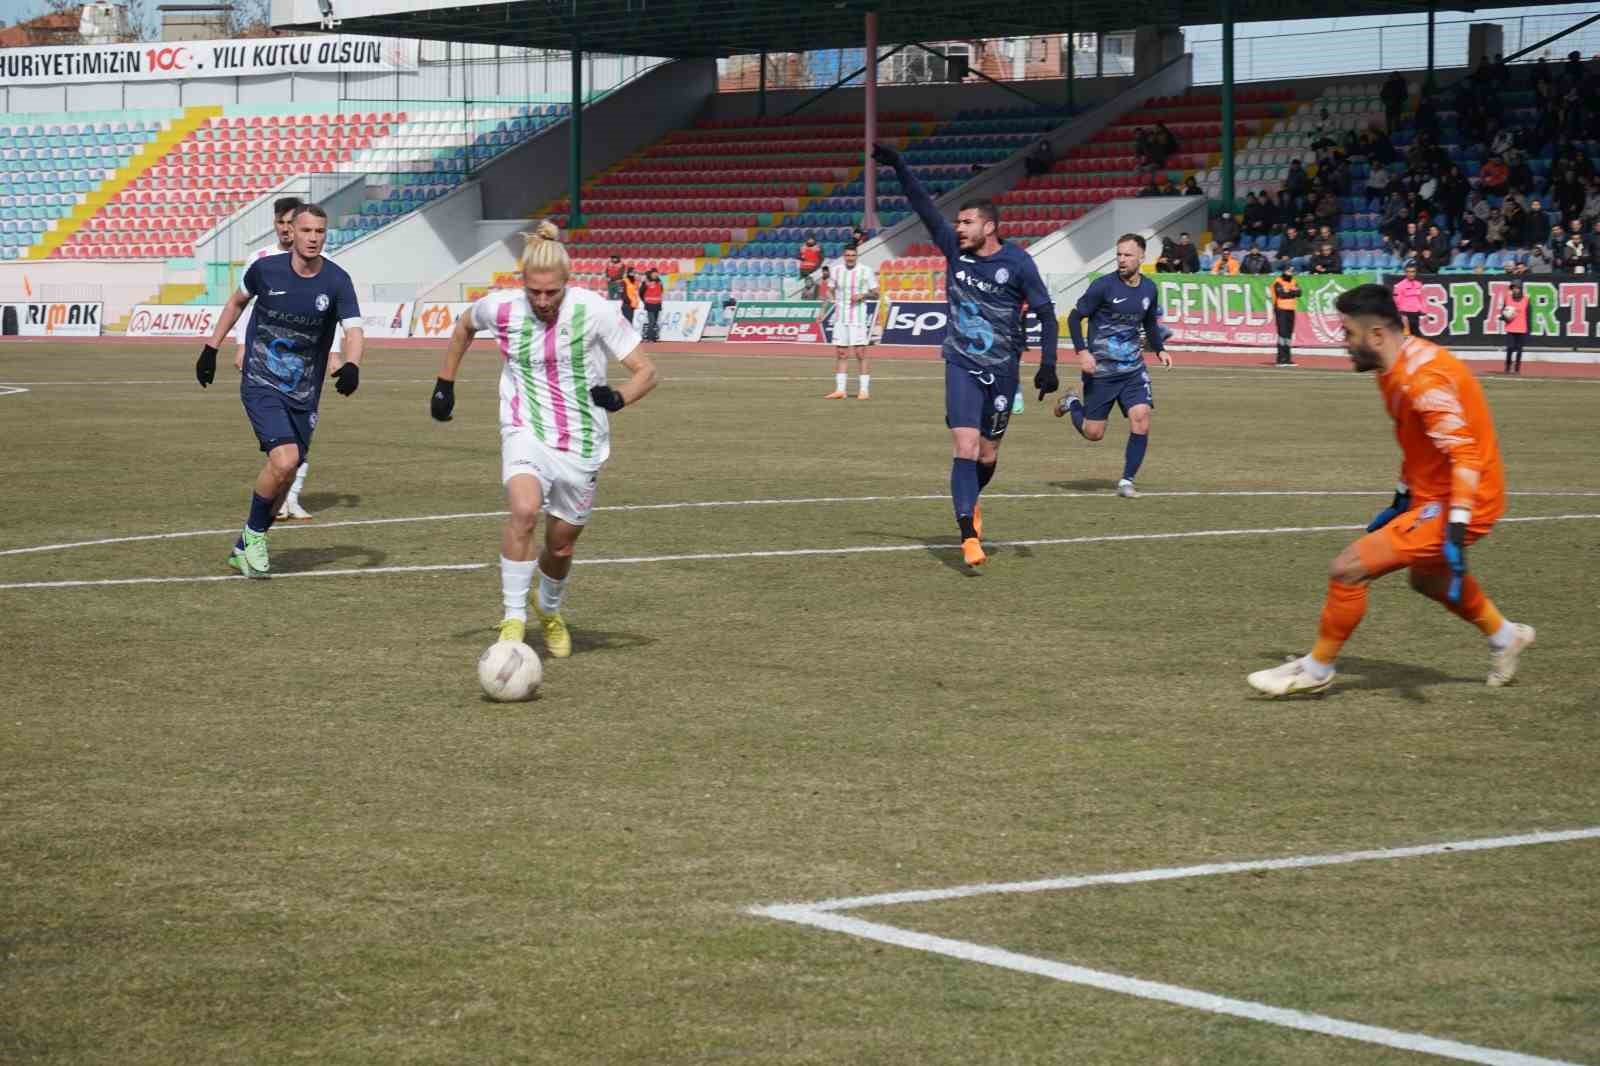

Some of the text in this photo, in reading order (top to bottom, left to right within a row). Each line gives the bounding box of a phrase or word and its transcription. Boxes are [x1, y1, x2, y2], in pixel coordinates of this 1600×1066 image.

[213, 46, 247, 68] YILI
[252, 43, 312, 67] KUTLU
[318, 41, 381, 63] OLSUN
[1419, 281, 1600, 337] SPART
